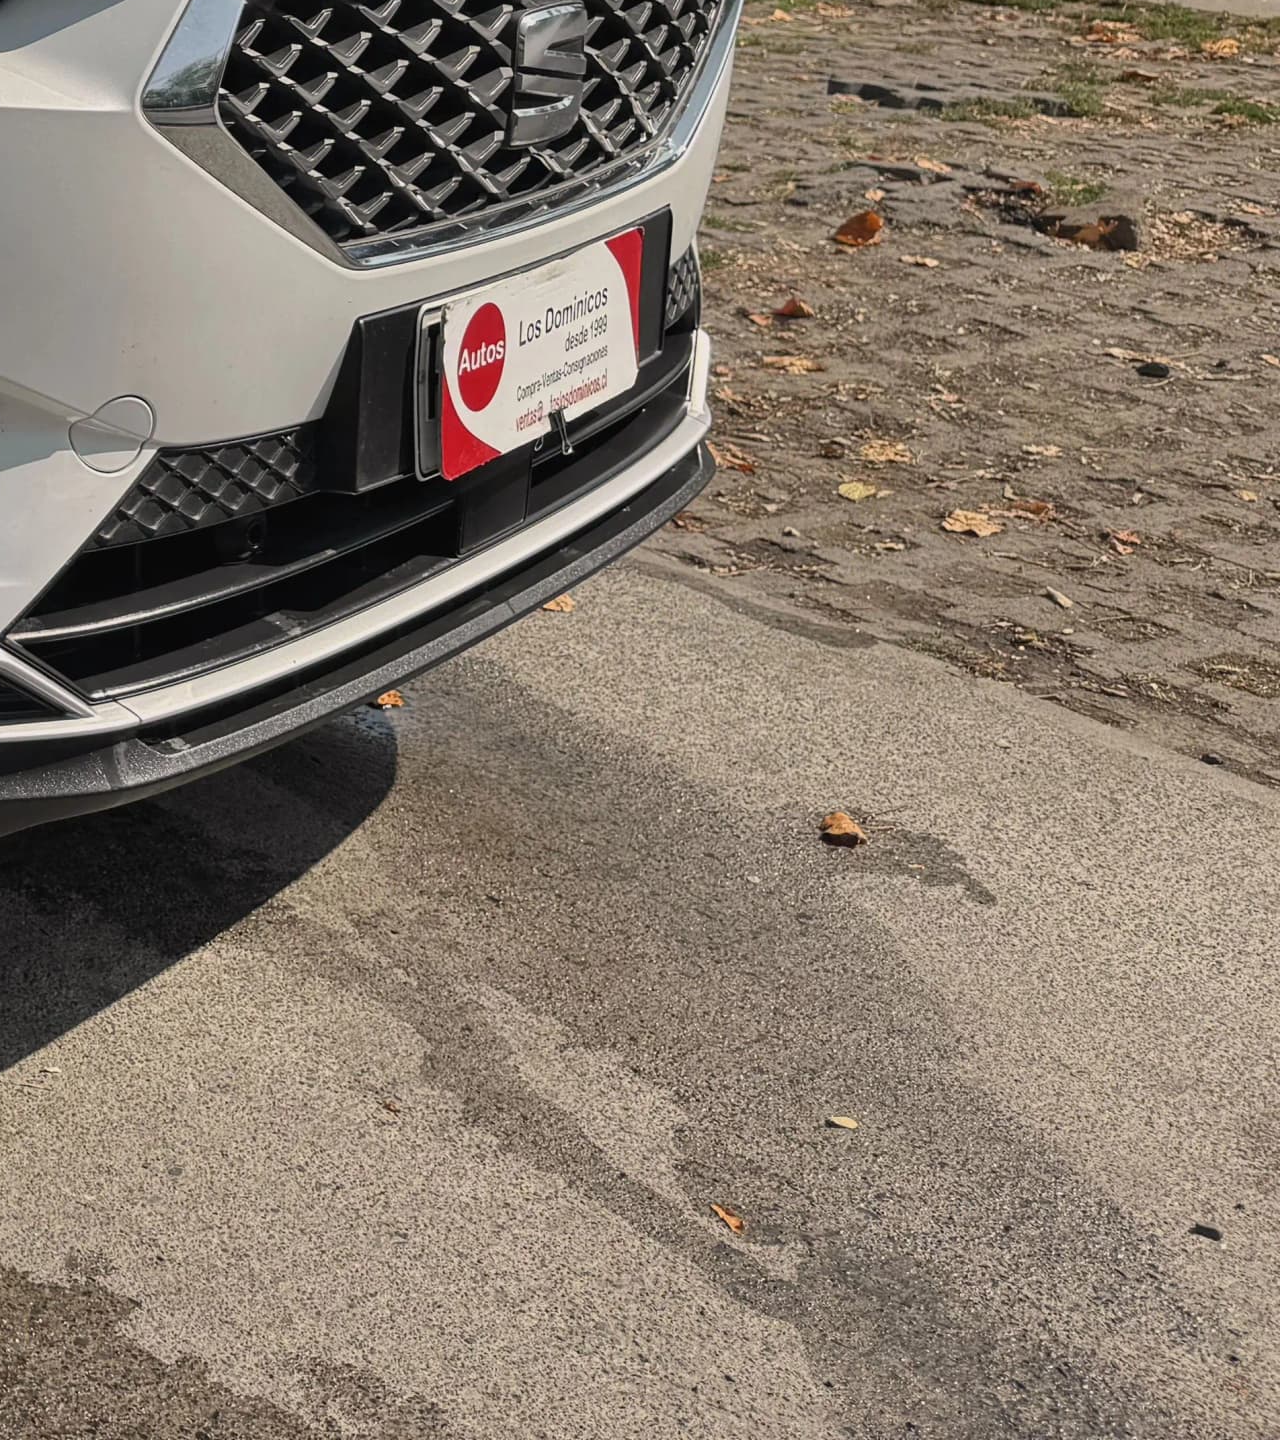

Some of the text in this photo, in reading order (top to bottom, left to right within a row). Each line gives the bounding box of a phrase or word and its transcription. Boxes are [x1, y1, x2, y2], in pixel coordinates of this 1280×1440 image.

[519, 287, 608, 347] Los Dominicos
[564, 313, 608, 352] desde 1999
[458, 339, 505, 376] Autos
